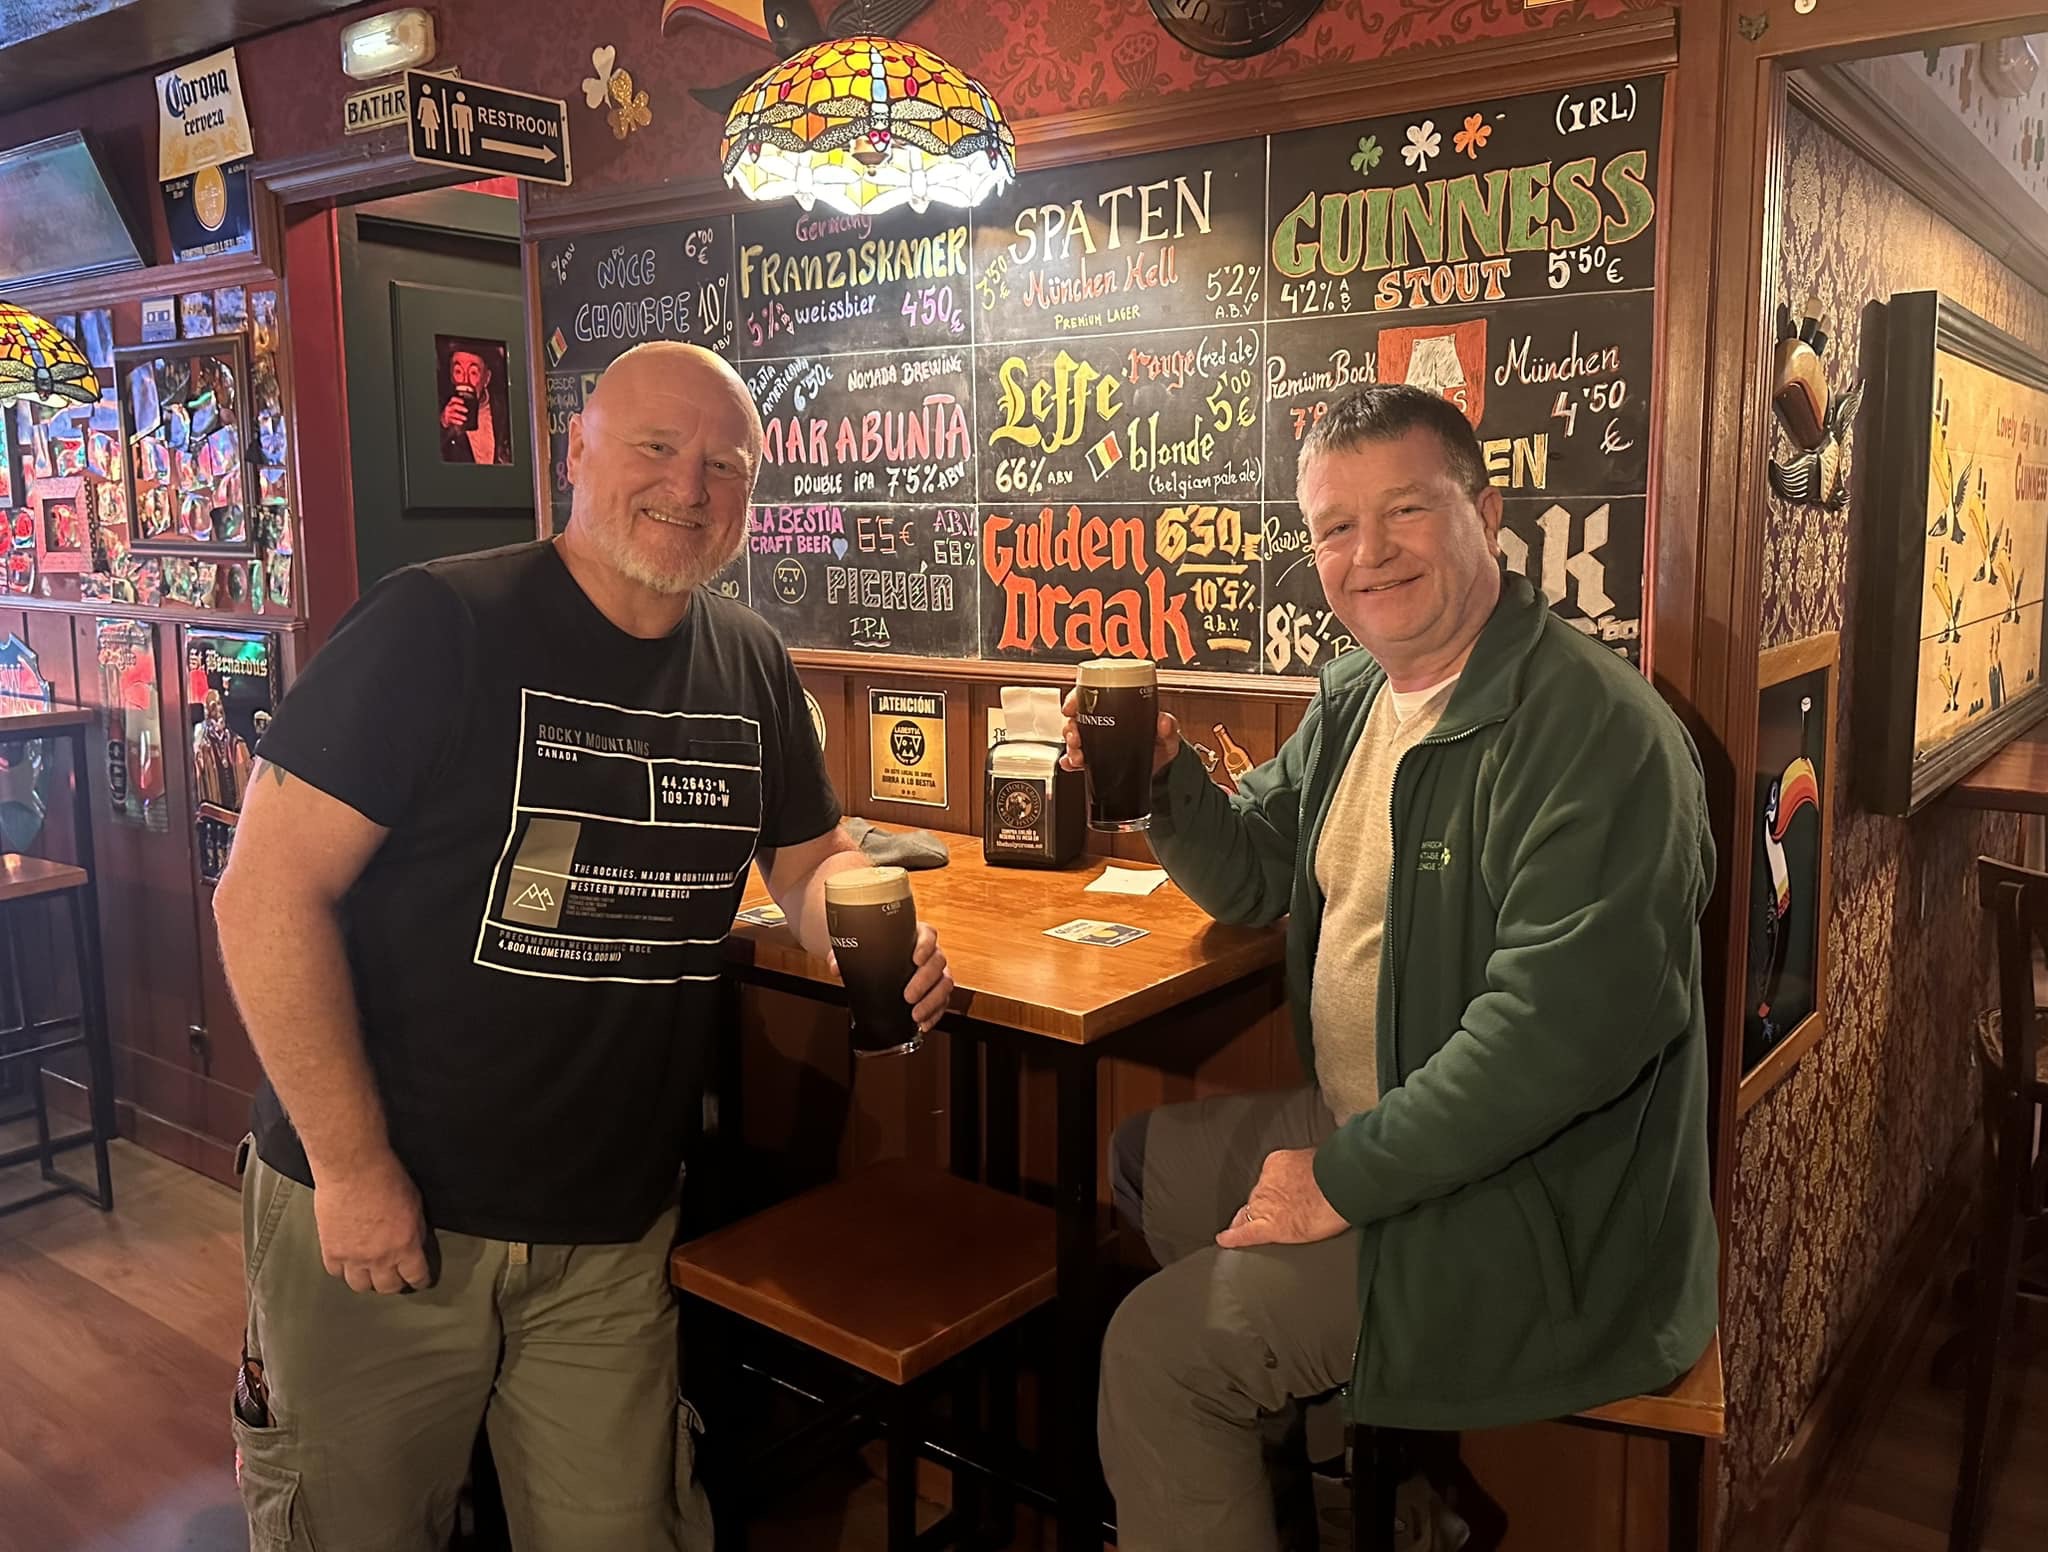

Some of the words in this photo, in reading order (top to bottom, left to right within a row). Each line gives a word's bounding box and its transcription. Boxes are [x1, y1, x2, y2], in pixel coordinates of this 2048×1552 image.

[165, 67, 231, 121] Corona
[348, 90, 406, 124] BATHR
[1556, 84, 1638, 136] (IRL)
[184, 108, 225, 137] cerveza
[477, 106, 558, 138] RESTROOM
[795, 214, 873, 242] Germany
[1008, 170, 1212, 266] SPATEN
[1272, 150, 1656, 279] GUINNESS
[740, 226, 968, 299] FRANZISKANER
[1024, 257, 1118, 310] München
[1123, 246, 1179, 293] Hell
[1374, 258, 1513, 311] STOUT
[575, 291, 691, 342] CHOUFFE
[698, 273, 734, 336] 10%
[794, 290, 877, 326] weissbier
[1106, 304, 1141, 324] LAGER
[1265, 355, 1334, 402] Premium
[1329, 348, 1379, 391] Bock
[1495, 331, 1620, 387] München
[848, 363, 898, 393] NOMADA
[989, 349, 1124, 454] Leffe
[1127, 411, 1215, 473] blonde
[1996, 408, 2018, 448] Lovely
[794, 472, 843, 497] DOUBLE
[936, 461, 967, 492] ABV
[1149, 470, 1213, 500] (belgian
[750, 507, 775, 535] LA
[778, 505, 845, 535] BESTIA
[750, 535, 792, 554] CRAFT
[797, 534, 832, 554] BEER
[983, 504, 1150, 586] Gulden
[997, 567, 1198, 665] Draak
[879, 696, 935, 713] ¡ATENCIÓN!
[537, 748, 578, 762] CANADA
[538, 724, 582, 744] ROCKY
[585, 732, 650, 756] MOUNTAINS
[915, 779, 936, 788] BESTIA
[570, 882, 615, 896] WESTERN
[616, 886, 648, 898] NORTH
[651, 888, 691, 900] AMERICA
[574, 863, 590, 875] THE
[640, 869, 671, 882] MAJOR
[674, 871, 715, 883] MOUNTAIN
[526, 944, 582, 961] KILOMETRES
